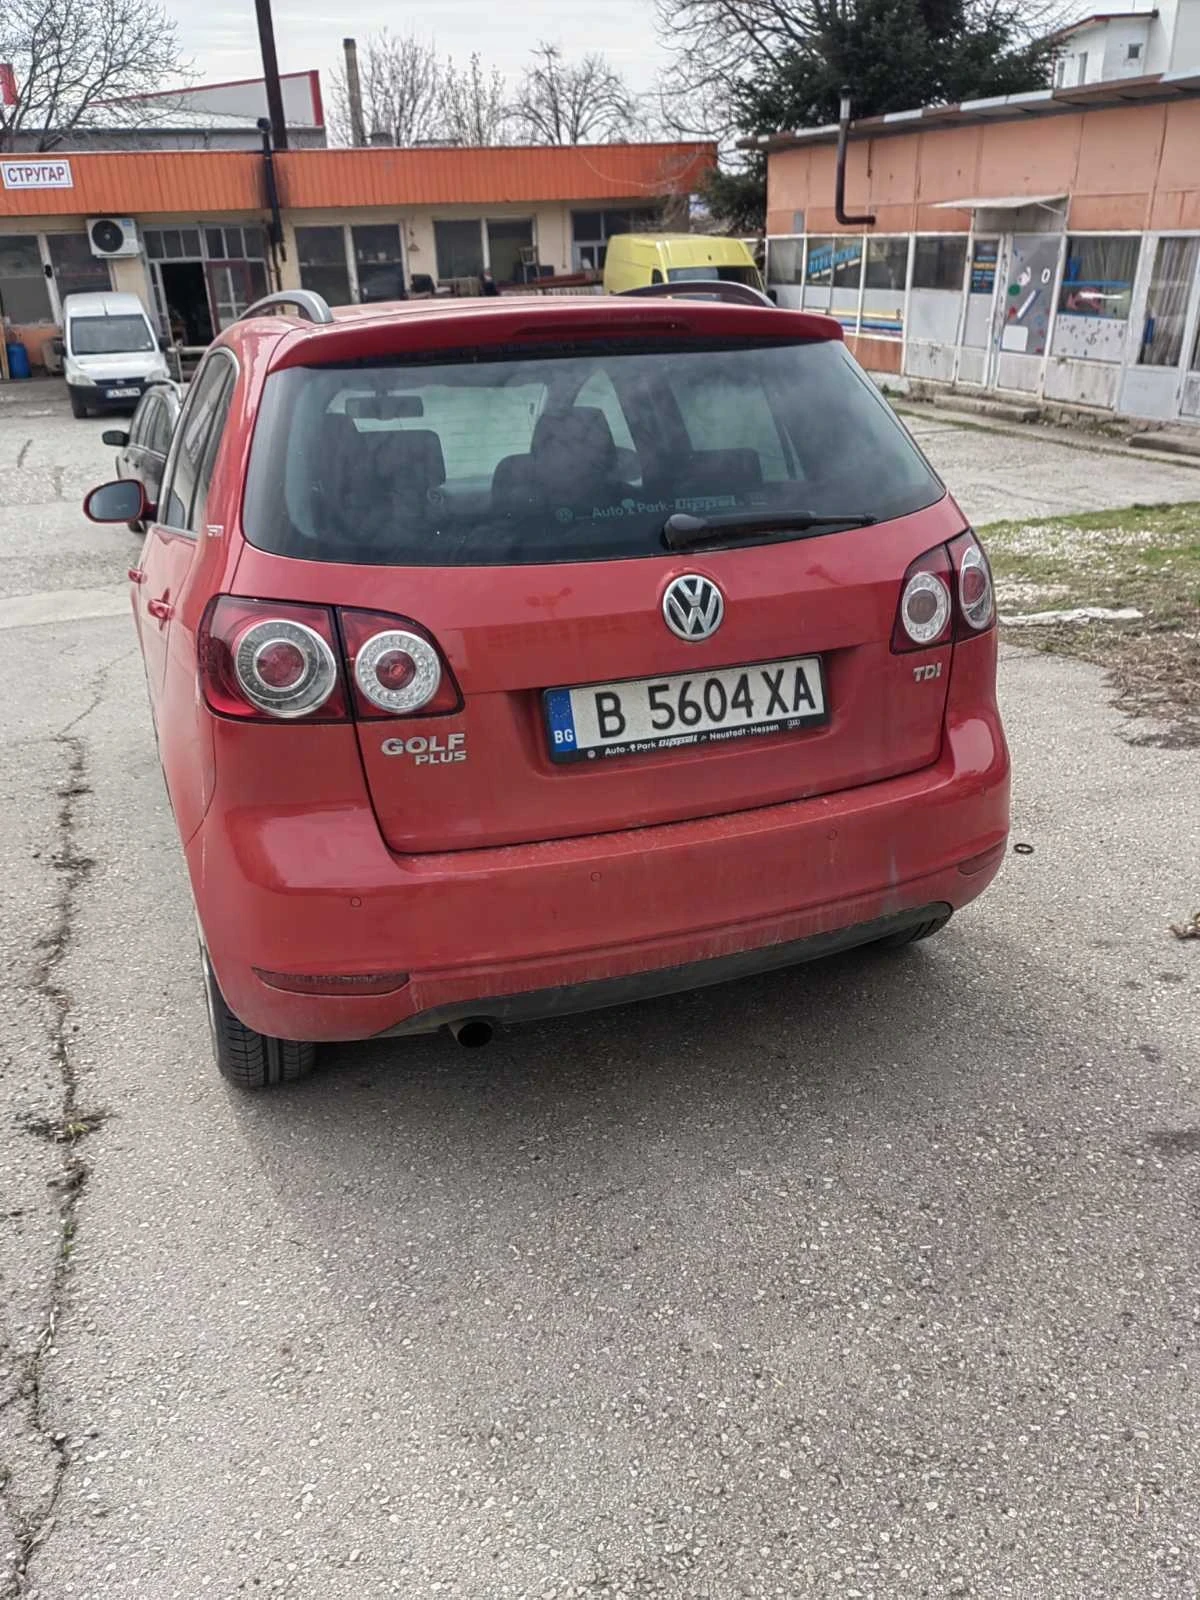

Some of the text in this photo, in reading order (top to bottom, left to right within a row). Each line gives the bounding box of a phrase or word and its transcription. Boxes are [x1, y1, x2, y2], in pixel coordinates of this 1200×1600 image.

[8, 166, 65, 182] СТРУГАР
[592, 506, 624, 519] Auto
[913, 662, 942, 682] TDI
[595, 666, 817, 739] B 5604 XA
[381, 733, 465, 755] GOLF
[554, 730, 574, 744] BG
[605, 744, 625, 756] Auto
[637, 742, 656, 751] Park
[415, 750, 467, 766] PLUS
